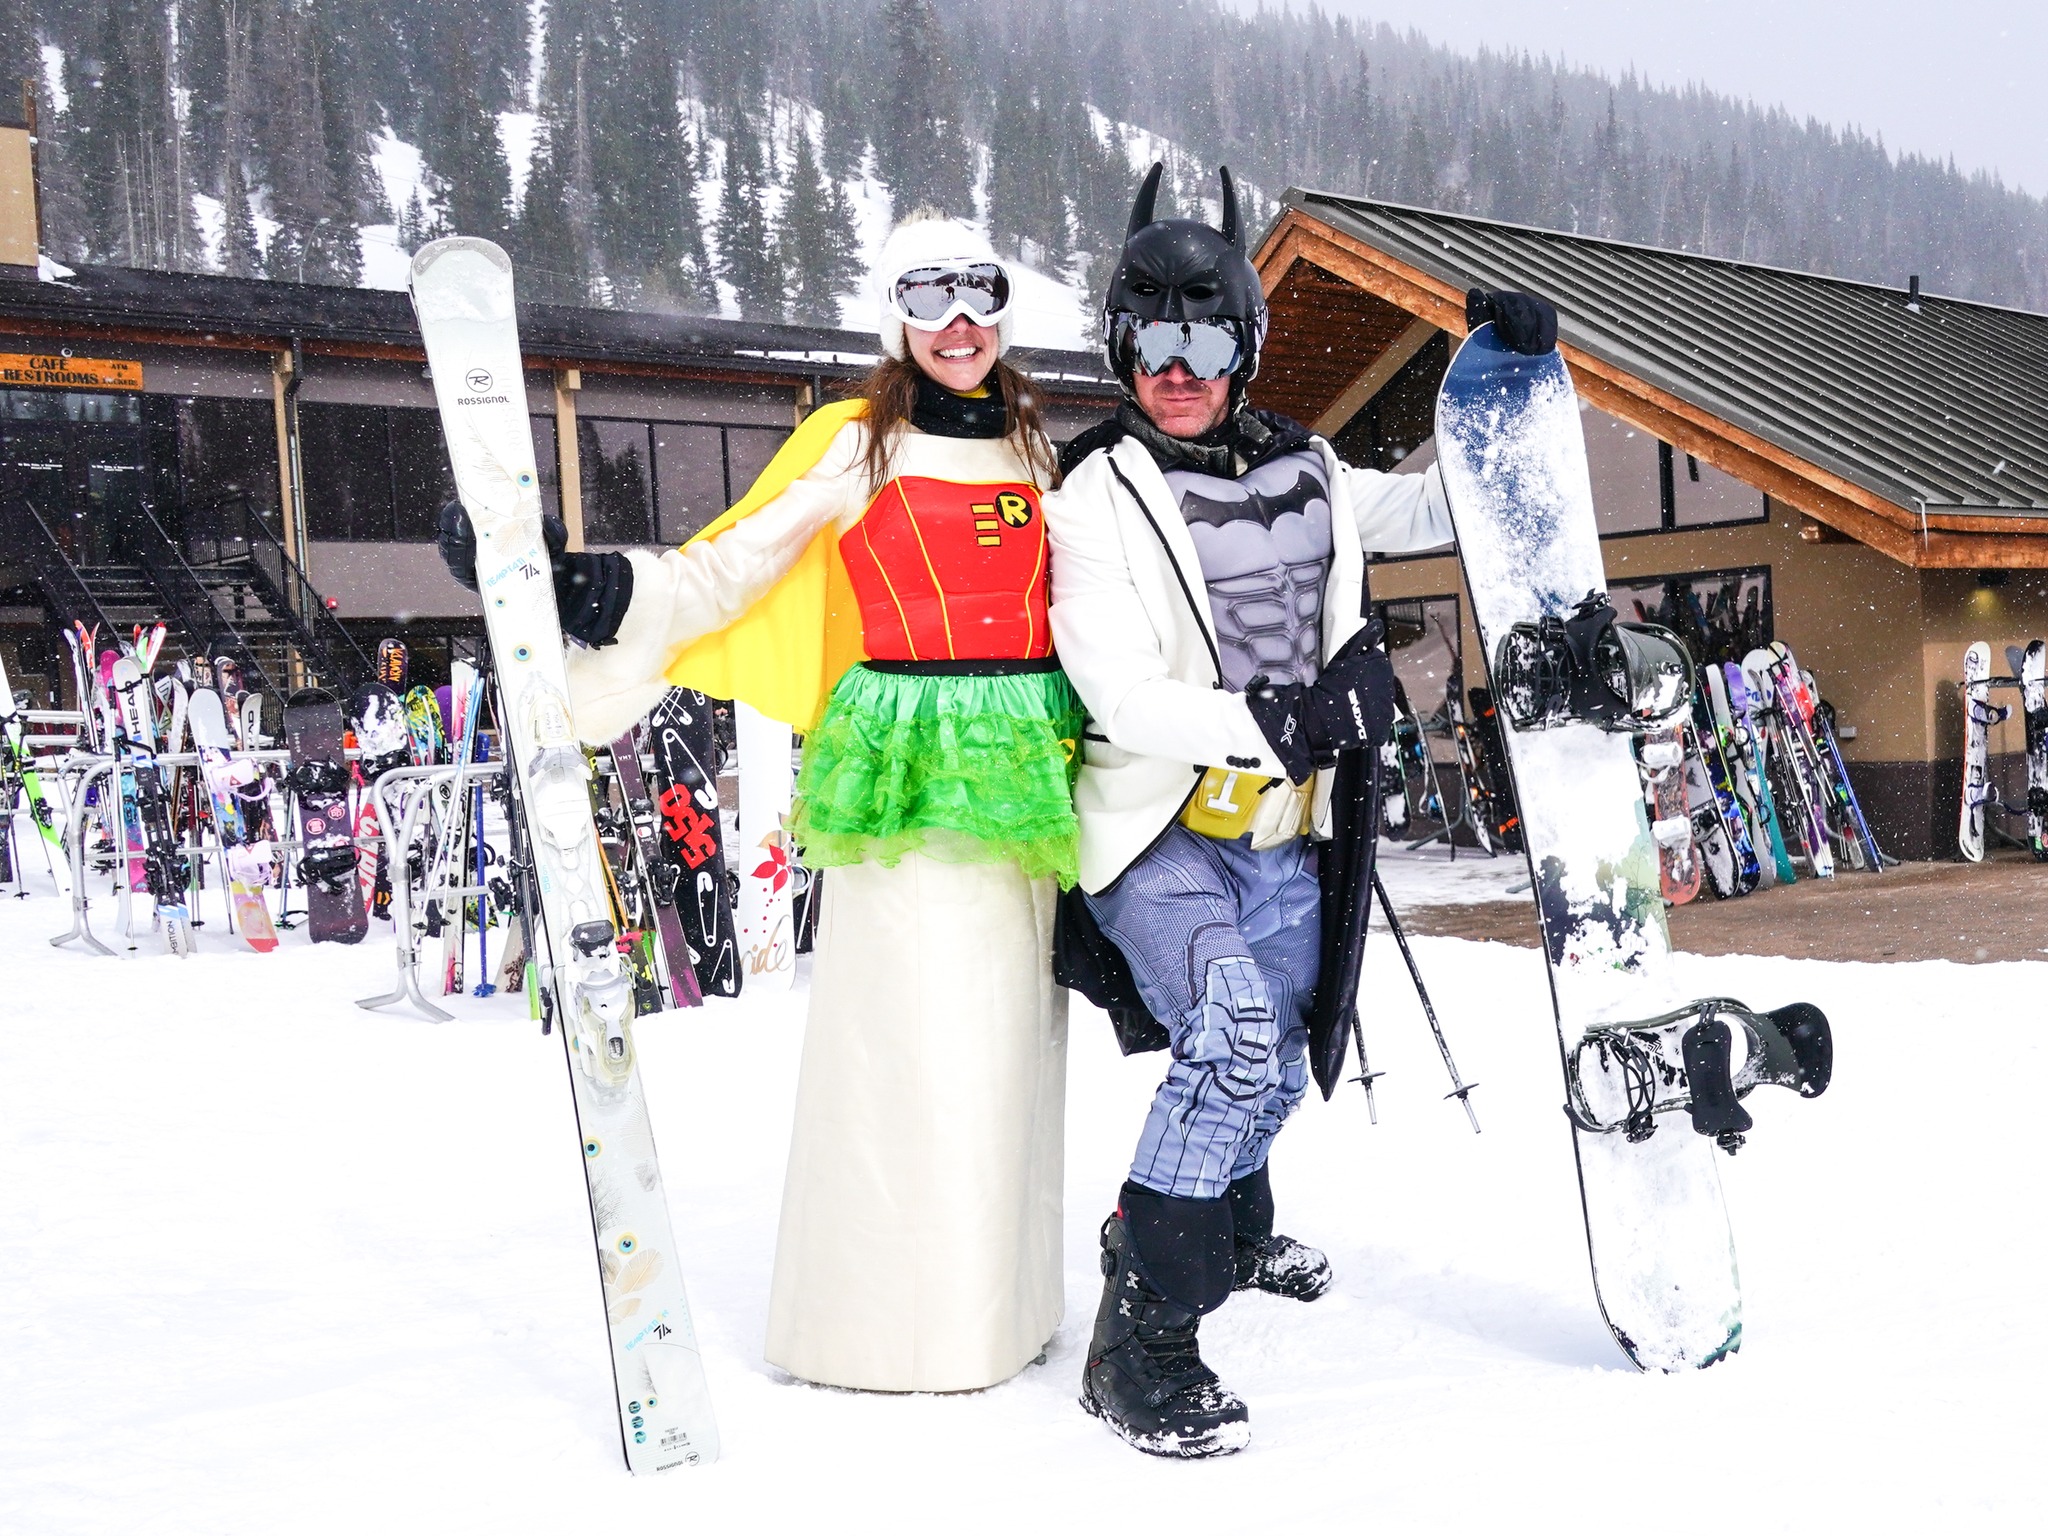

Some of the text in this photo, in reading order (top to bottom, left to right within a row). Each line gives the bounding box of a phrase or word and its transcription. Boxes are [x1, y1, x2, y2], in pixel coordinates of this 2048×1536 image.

[29, 358, 69, 371] CAFE
[4, 369, 99, 385] RESTROOMS
[457, 395, 510, 406] ROSSIGNOL
[999, 495, 1029, 526] R
[485, 547, 538, 588] TEMPTATIN
[519, 562, 541, 581] 74
[126, 680, 141, 735] HEAD
[1347, 688, 1367, 740] DAKINE
[653, 1323, 672, 1340] 74
